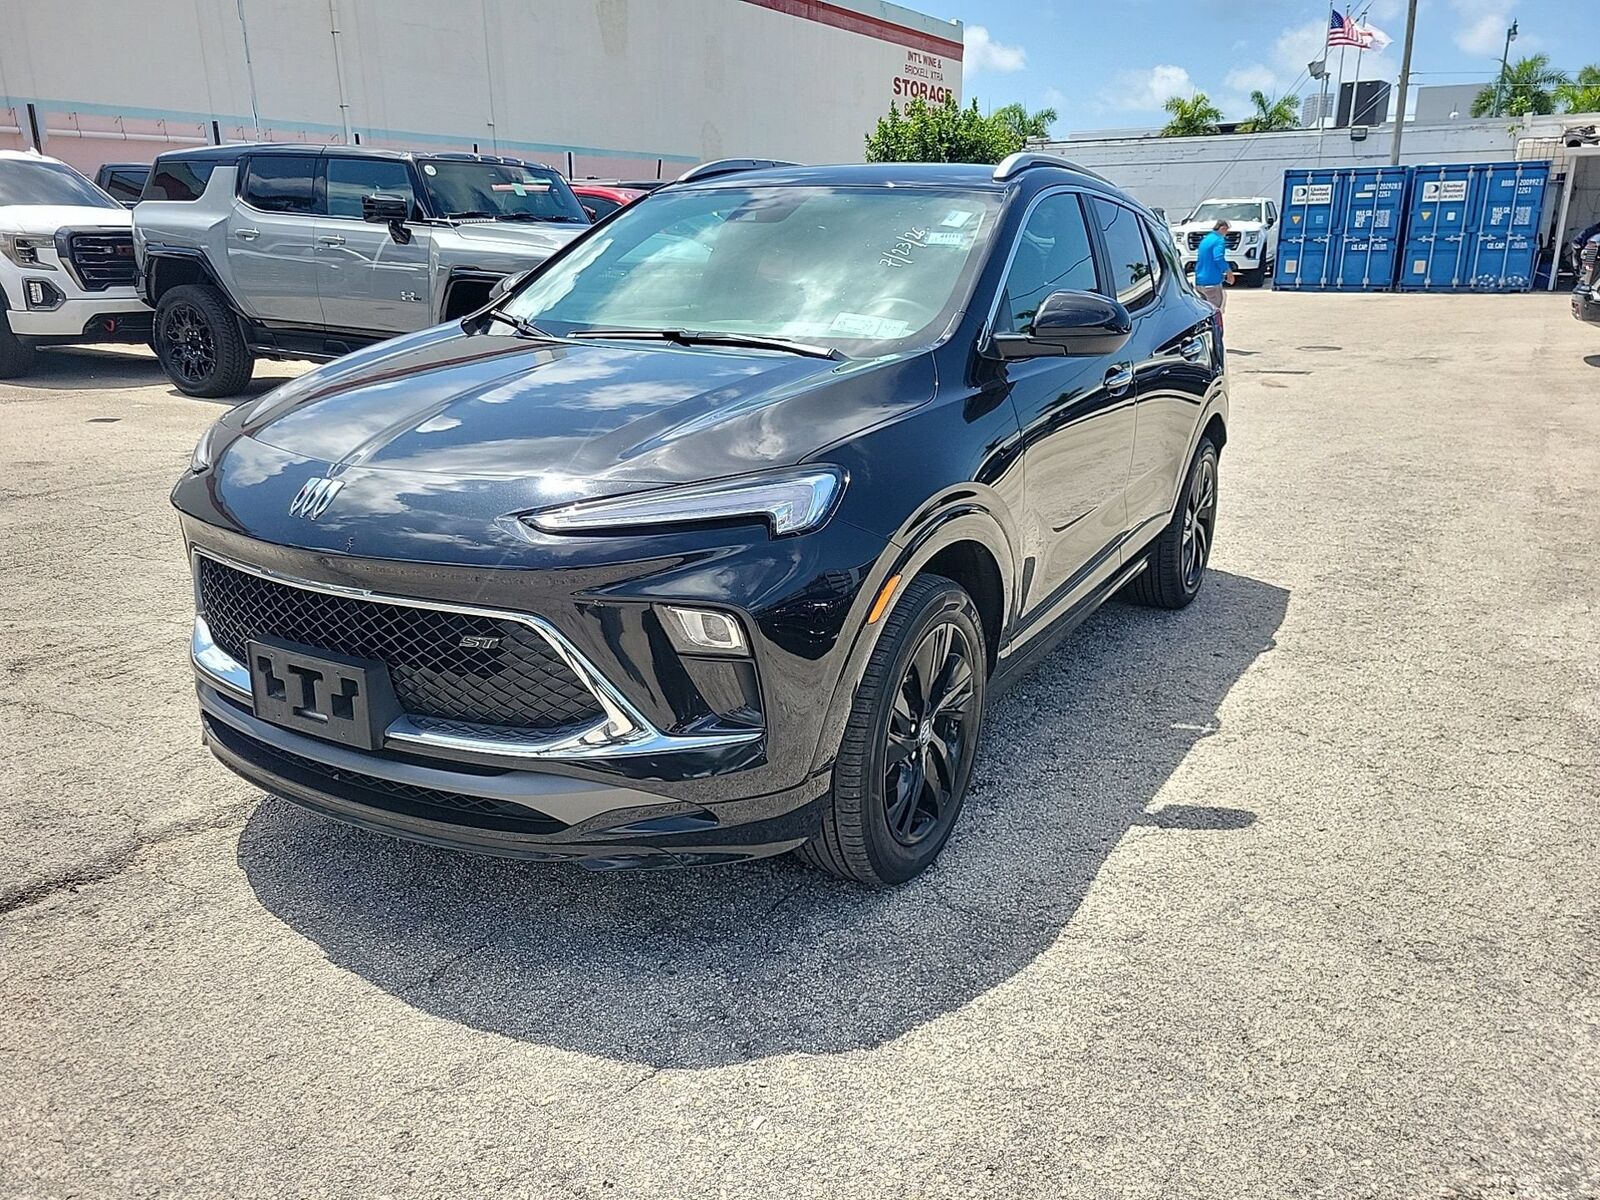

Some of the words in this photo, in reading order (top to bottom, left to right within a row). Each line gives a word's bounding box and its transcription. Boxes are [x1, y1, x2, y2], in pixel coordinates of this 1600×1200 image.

[923, 55, 936, 68] WINE
[904, 63, 929, 79] BRICKELL
[930, 71, 944, 82] XTRA
[879, 226, 927, 267] 7/23/26
